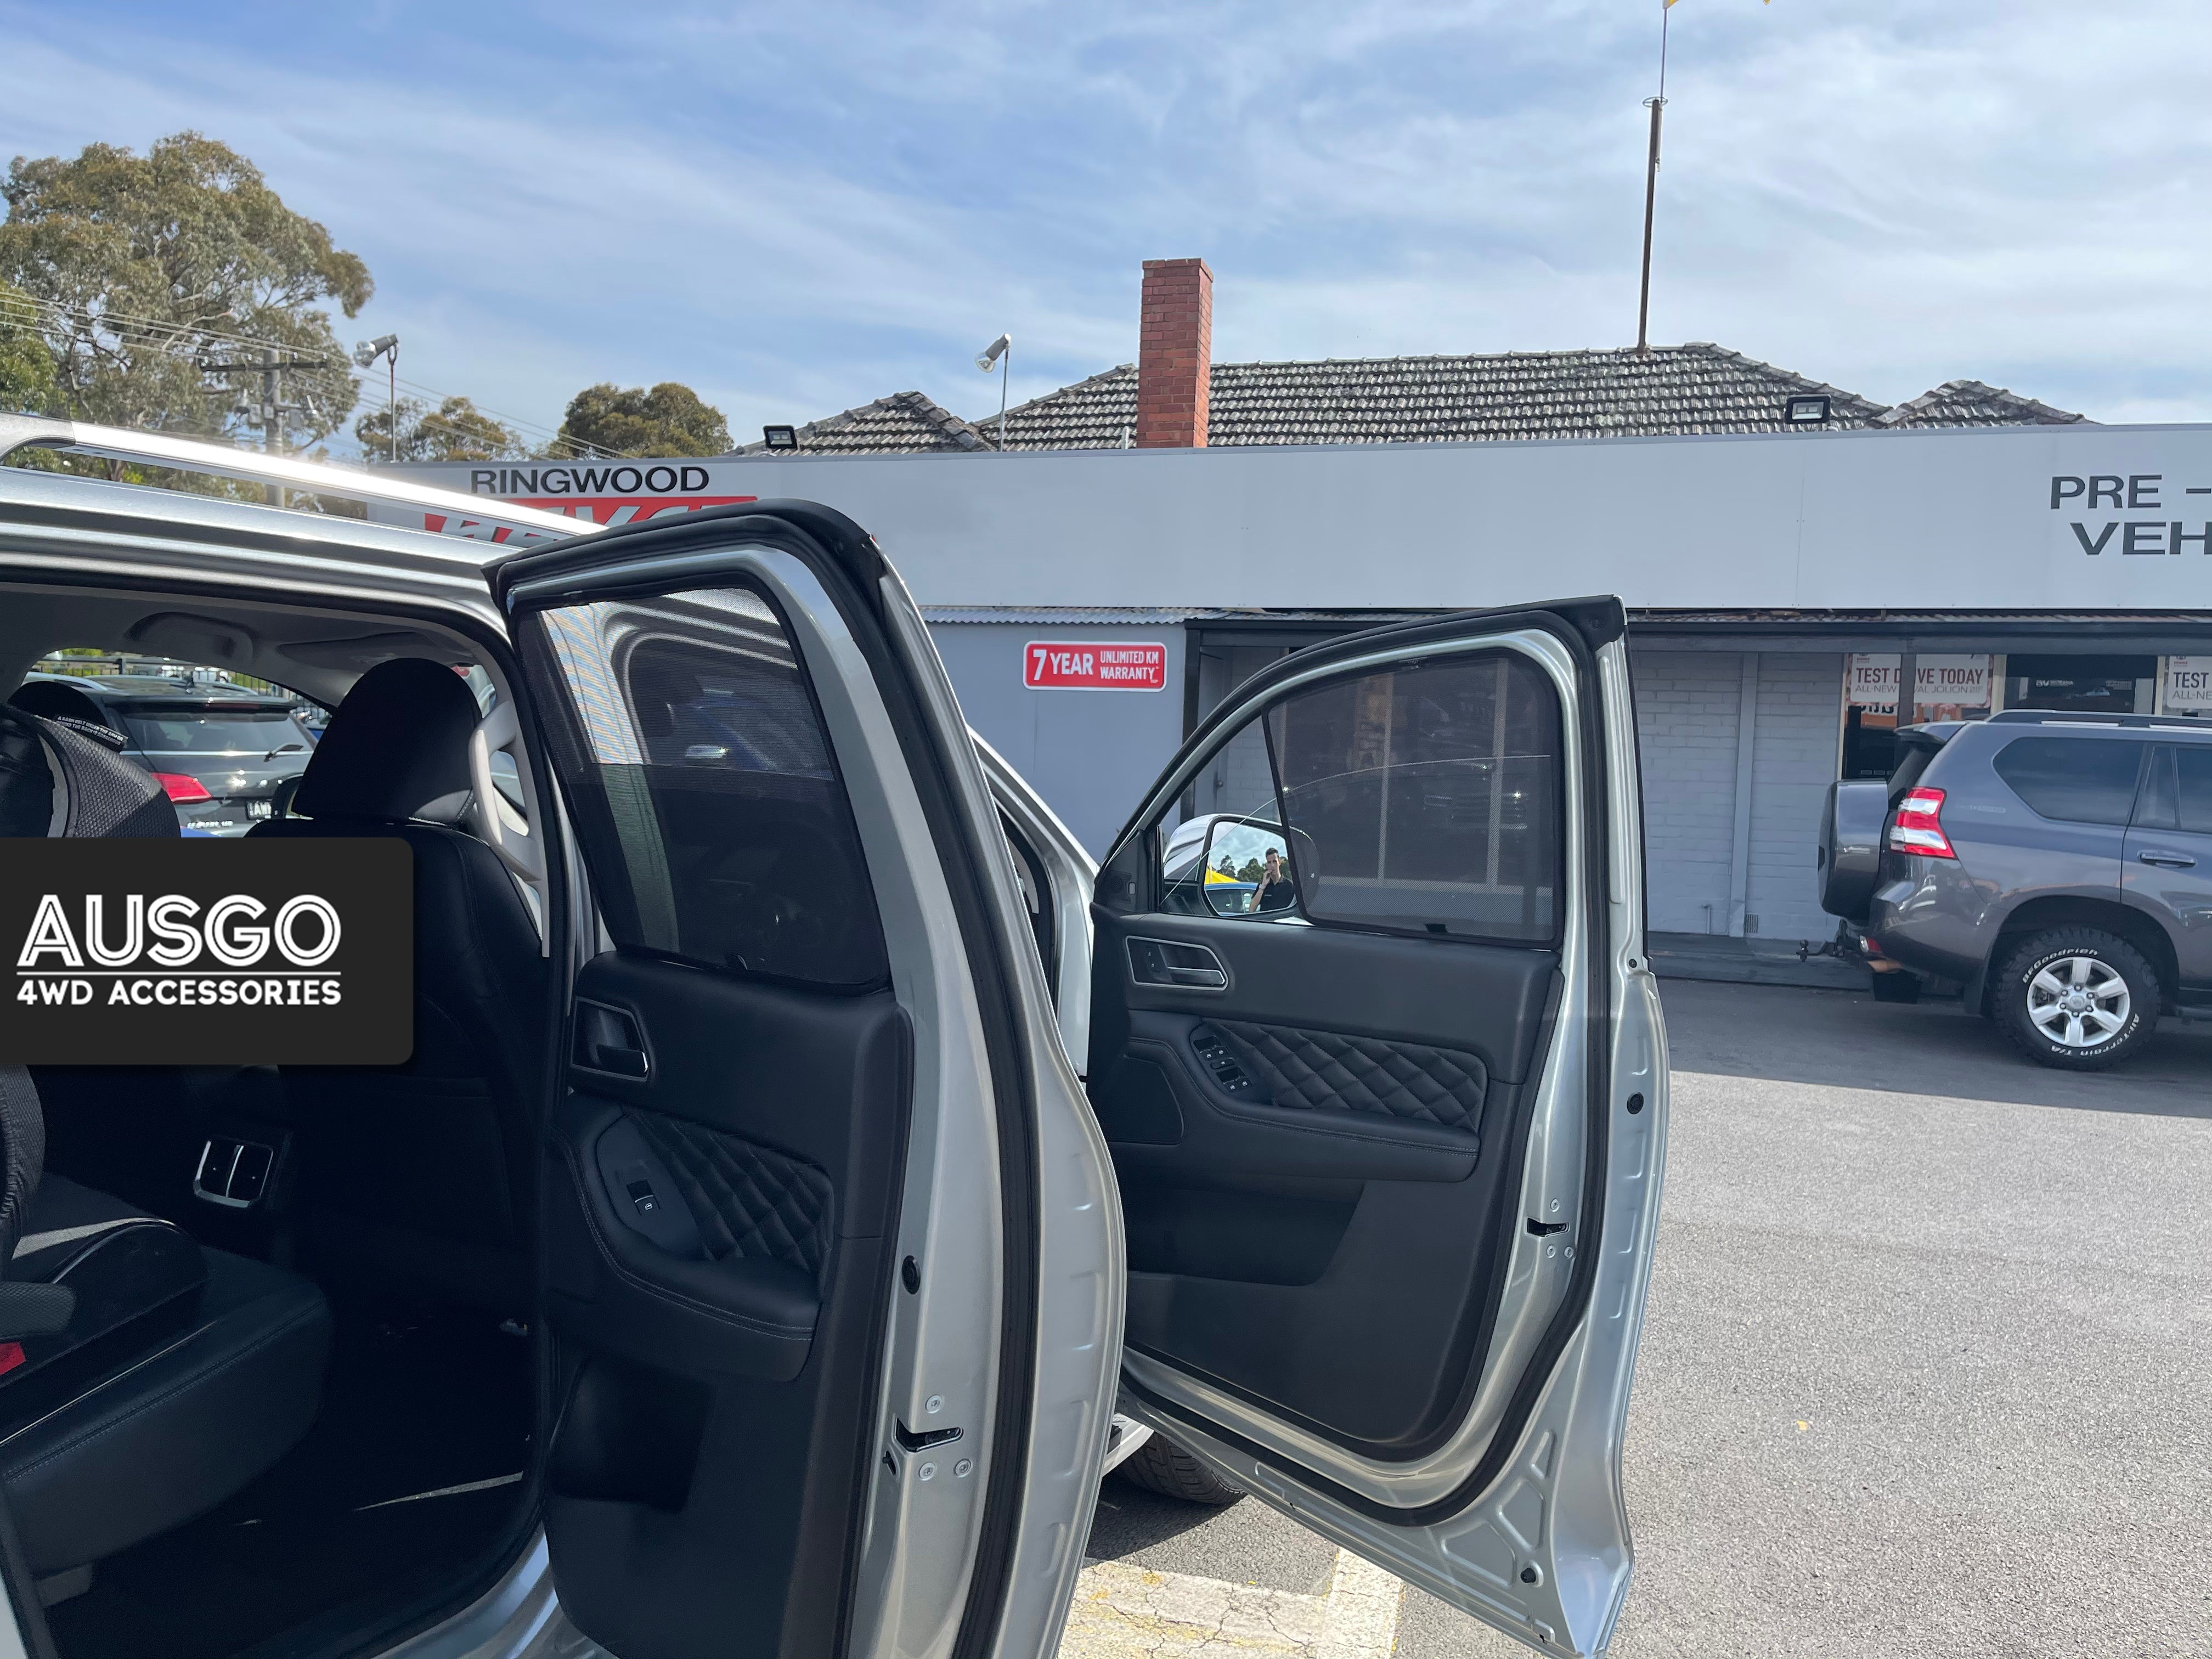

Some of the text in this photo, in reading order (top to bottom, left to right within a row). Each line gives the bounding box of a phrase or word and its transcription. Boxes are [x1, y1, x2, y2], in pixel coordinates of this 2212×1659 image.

[471, 466, 709, 494] RINGWOOD
[2051, 475, 2162, 509] PRE
[2070, 522, 2212, 555] VEH
[1032, 649, 1093, 681] 7 YEAR
[1099, 651, 1159, 664] UNLIMITED KM
[1856, 668, 1890, 684] TEST
[1939, 668, 1984, 685] TODAY
[2173, 672, 2209, 689] TEST
[1855, 685, 1897, 693] ALL-NEW
[1931, 685, 1968, 694] JOLION
